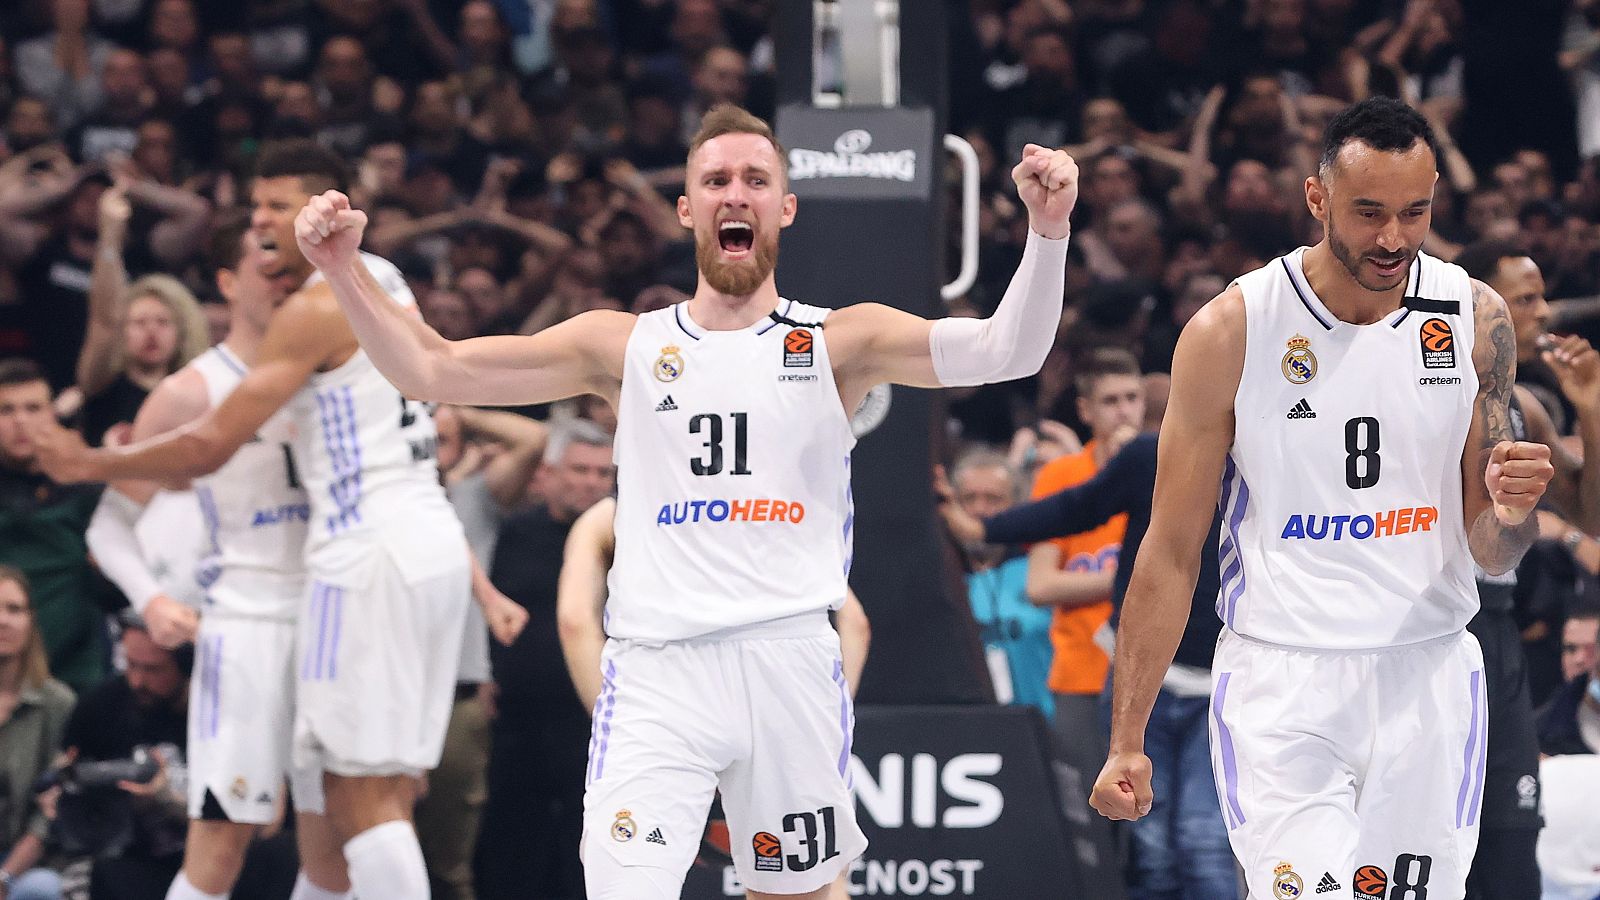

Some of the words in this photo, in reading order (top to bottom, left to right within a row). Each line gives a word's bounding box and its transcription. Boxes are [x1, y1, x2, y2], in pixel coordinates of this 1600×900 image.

[788, 148, 916, 181] SPALDING
[1419, 376, 1461, 385] oneteam
[1287, 411, 1317, 419] adidas
[688, 412, 752, 476] 31
[1344, 416, 1381, 489] 8
[657, 499, 805, 526] AUTOHERO
[782, 806, 840, 872] 31
[1315, 882, 1342, 894] adidas
[1390, 853, 1432, 900] 8
